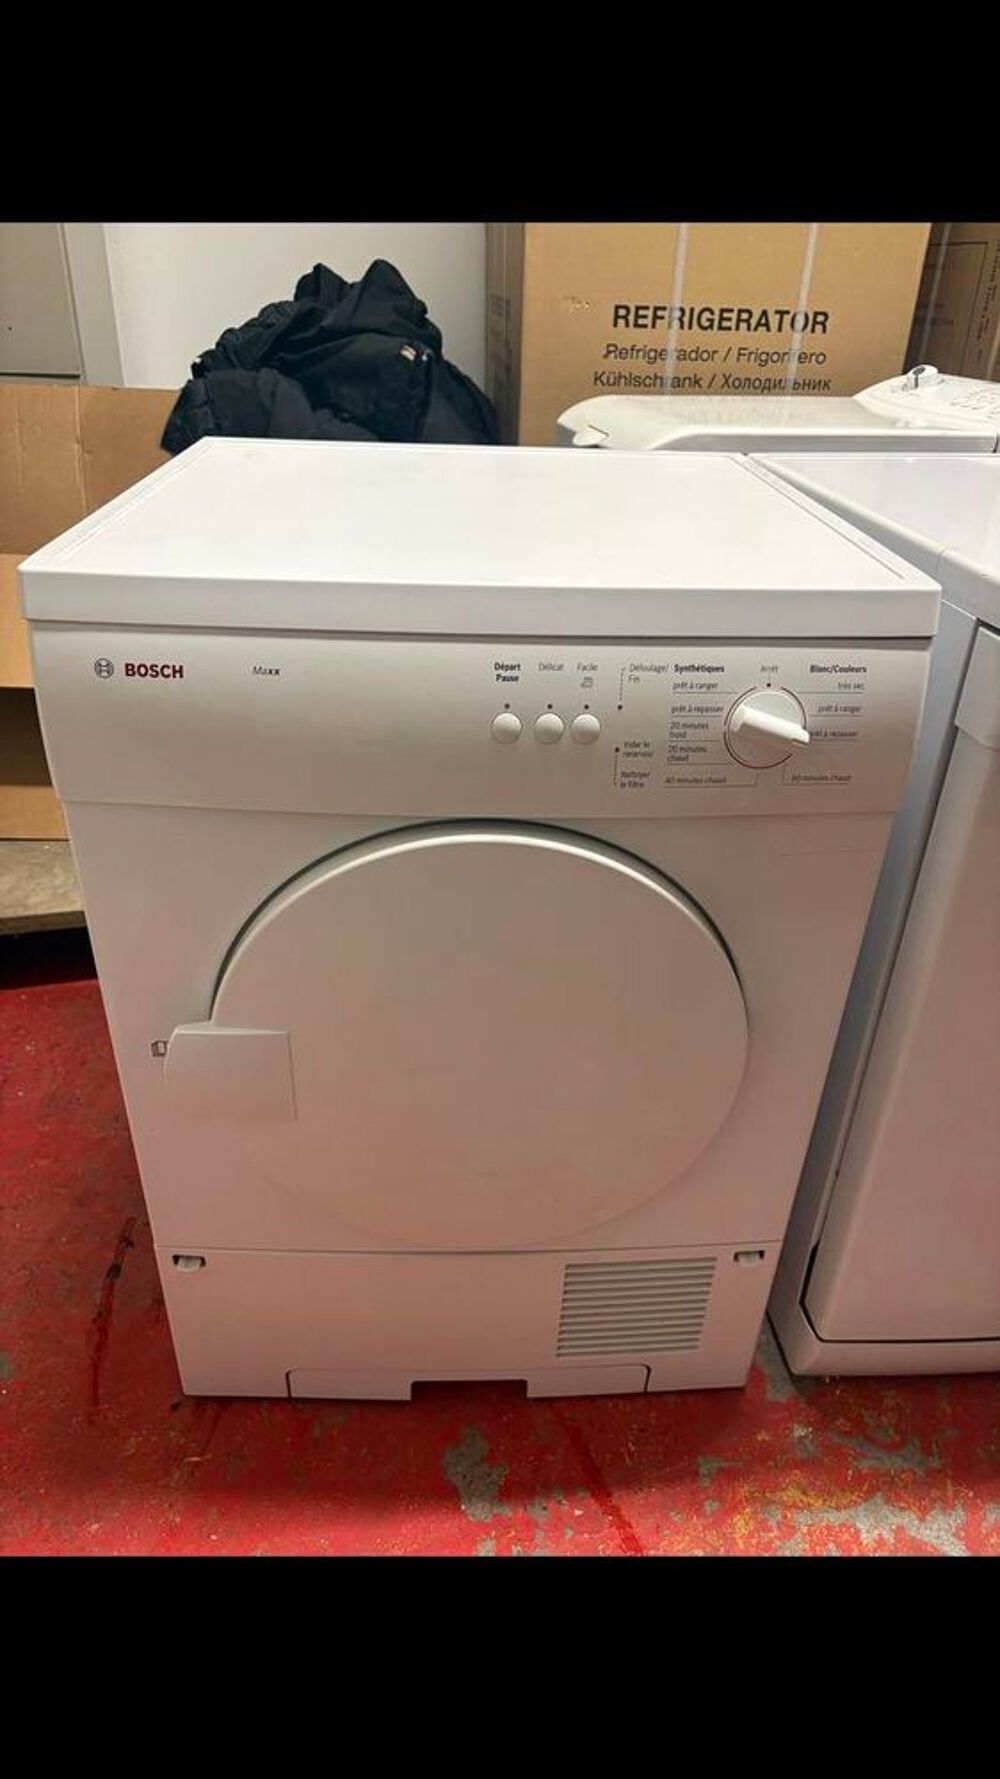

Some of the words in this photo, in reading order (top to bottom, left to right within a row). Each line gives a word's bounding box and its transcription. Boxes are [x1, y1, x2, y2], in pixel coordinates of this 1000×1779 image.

[613, 304, 829, 334] REFRIGERATOR
[606, 344, 717, 363] Refrigeador
[593, 371, 703, 389] Kühlschank
[721, 374, 832, 393] Холодиьник
[124, 663, 184, 679] BOSCH
[252, 665, 281, 677] Maxx
[494, 661, 521, 673] Départ
[538, 662, 565, 672] Délicat
[577, 663, 599, 672] Facile
[674, 664, 725, 674] Synthétiques
[810, 664, 867, 674] Blanc/Couleurs
[496, 674, 519, 683] Pause
[670, 722, 680, 730] 20
[681, 722, 709, 730] minutes
[668, 745, 679, 753] 20
[680, 745, 707, 753] minutes
[676, 776, 703, 784] minutes
